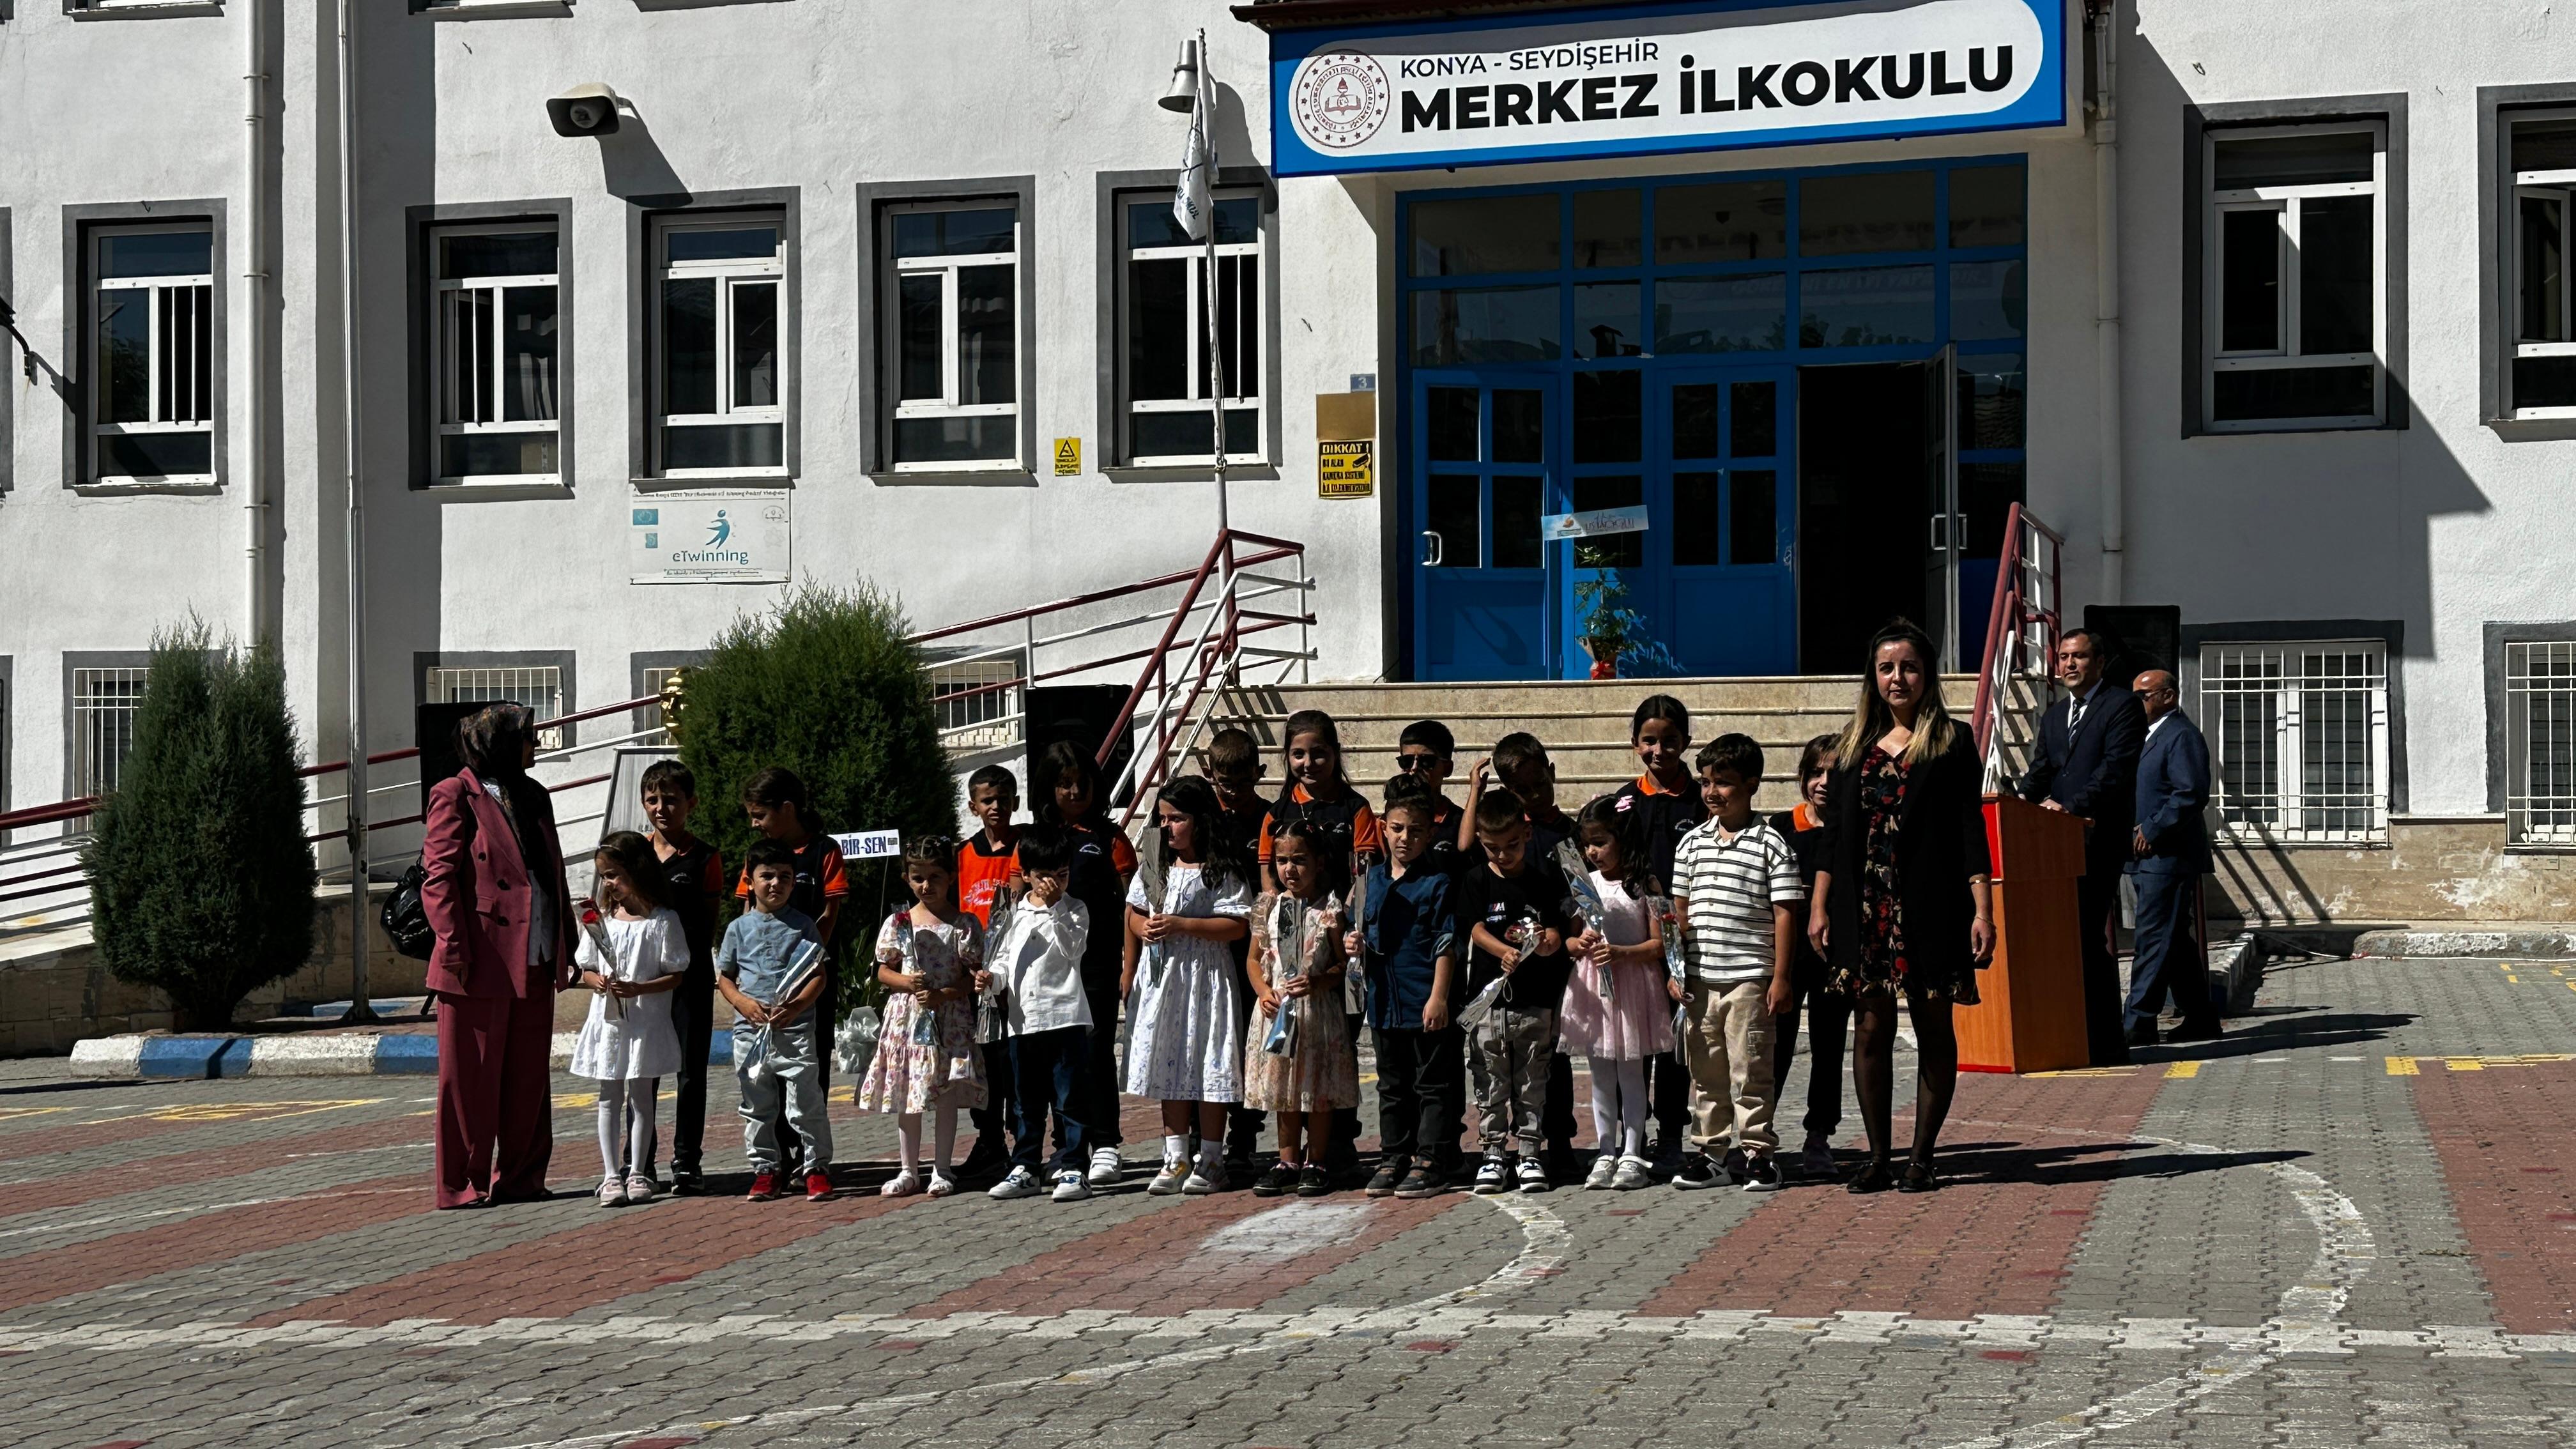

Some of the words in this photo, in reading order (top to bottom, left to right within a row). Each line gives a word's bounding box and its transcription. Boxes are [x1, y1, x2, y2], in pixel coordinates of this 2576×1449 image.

[1401, 56, 1487, 78] KONYA
[1509, 38, 1659, 70] SEYDİŞEHİR
[1401, 73, 1659, 134] MERKEZ
[1680, 45, 2013, 115] İLKOKULU
[1358, 377, 1367, 389] 3
[672, 550, 749, 565] eTwinning
